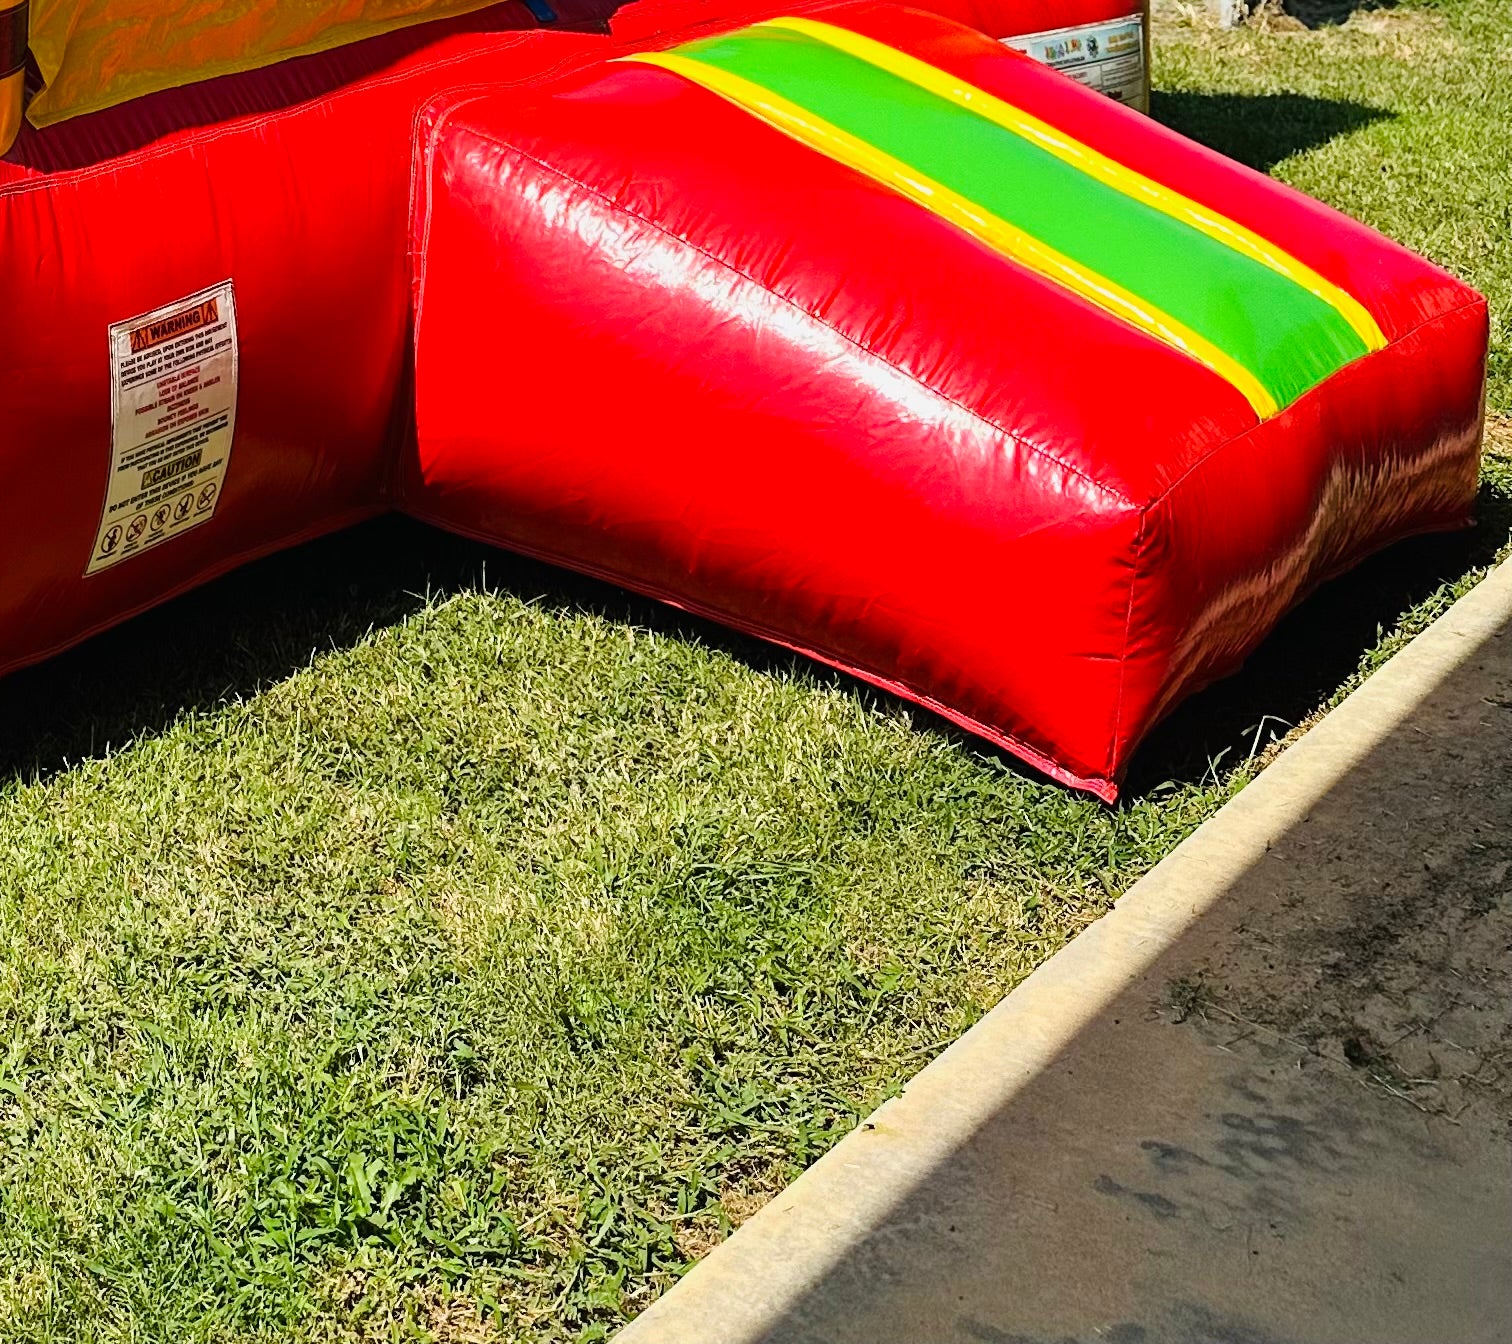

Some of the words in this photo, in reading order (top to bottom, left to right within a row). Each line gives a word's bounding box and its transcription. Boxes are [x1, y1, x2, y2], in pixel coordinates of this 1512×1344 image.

[150, 310, 200, 340] WARNING
[147, 360, 157, 368] PLAY
[173, 353, 195, 366] FOLLOWING
[152, 453, 199, 482] CAUTION
